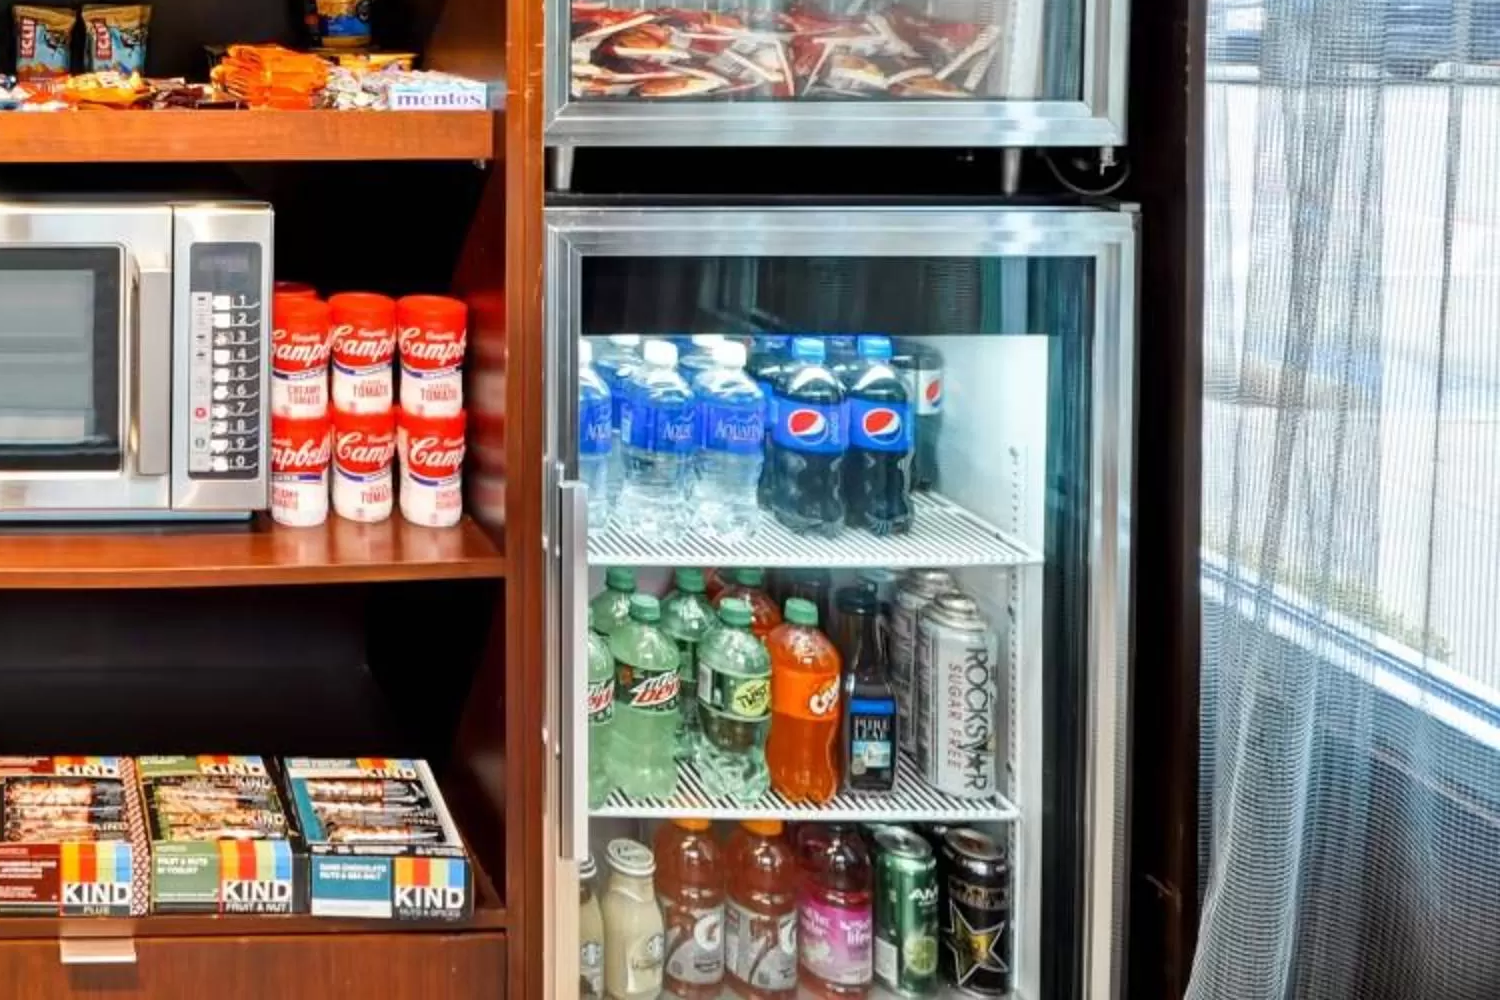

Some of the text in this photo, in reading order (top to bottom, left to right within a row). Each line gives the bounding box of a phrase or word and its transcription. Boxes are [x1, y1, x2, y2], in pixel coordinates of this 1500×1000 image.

[396, 91, 483, 106] mentos
[947, 663, 963, 720] SUGAR
[64, 882, 131, 905] KIND
[222, 880, 292, 902] KIND
[394, 886, 465, 909] KIND
[226, 903, 255, 913] FRUIT
[267, 903, 287, 913] NUT
